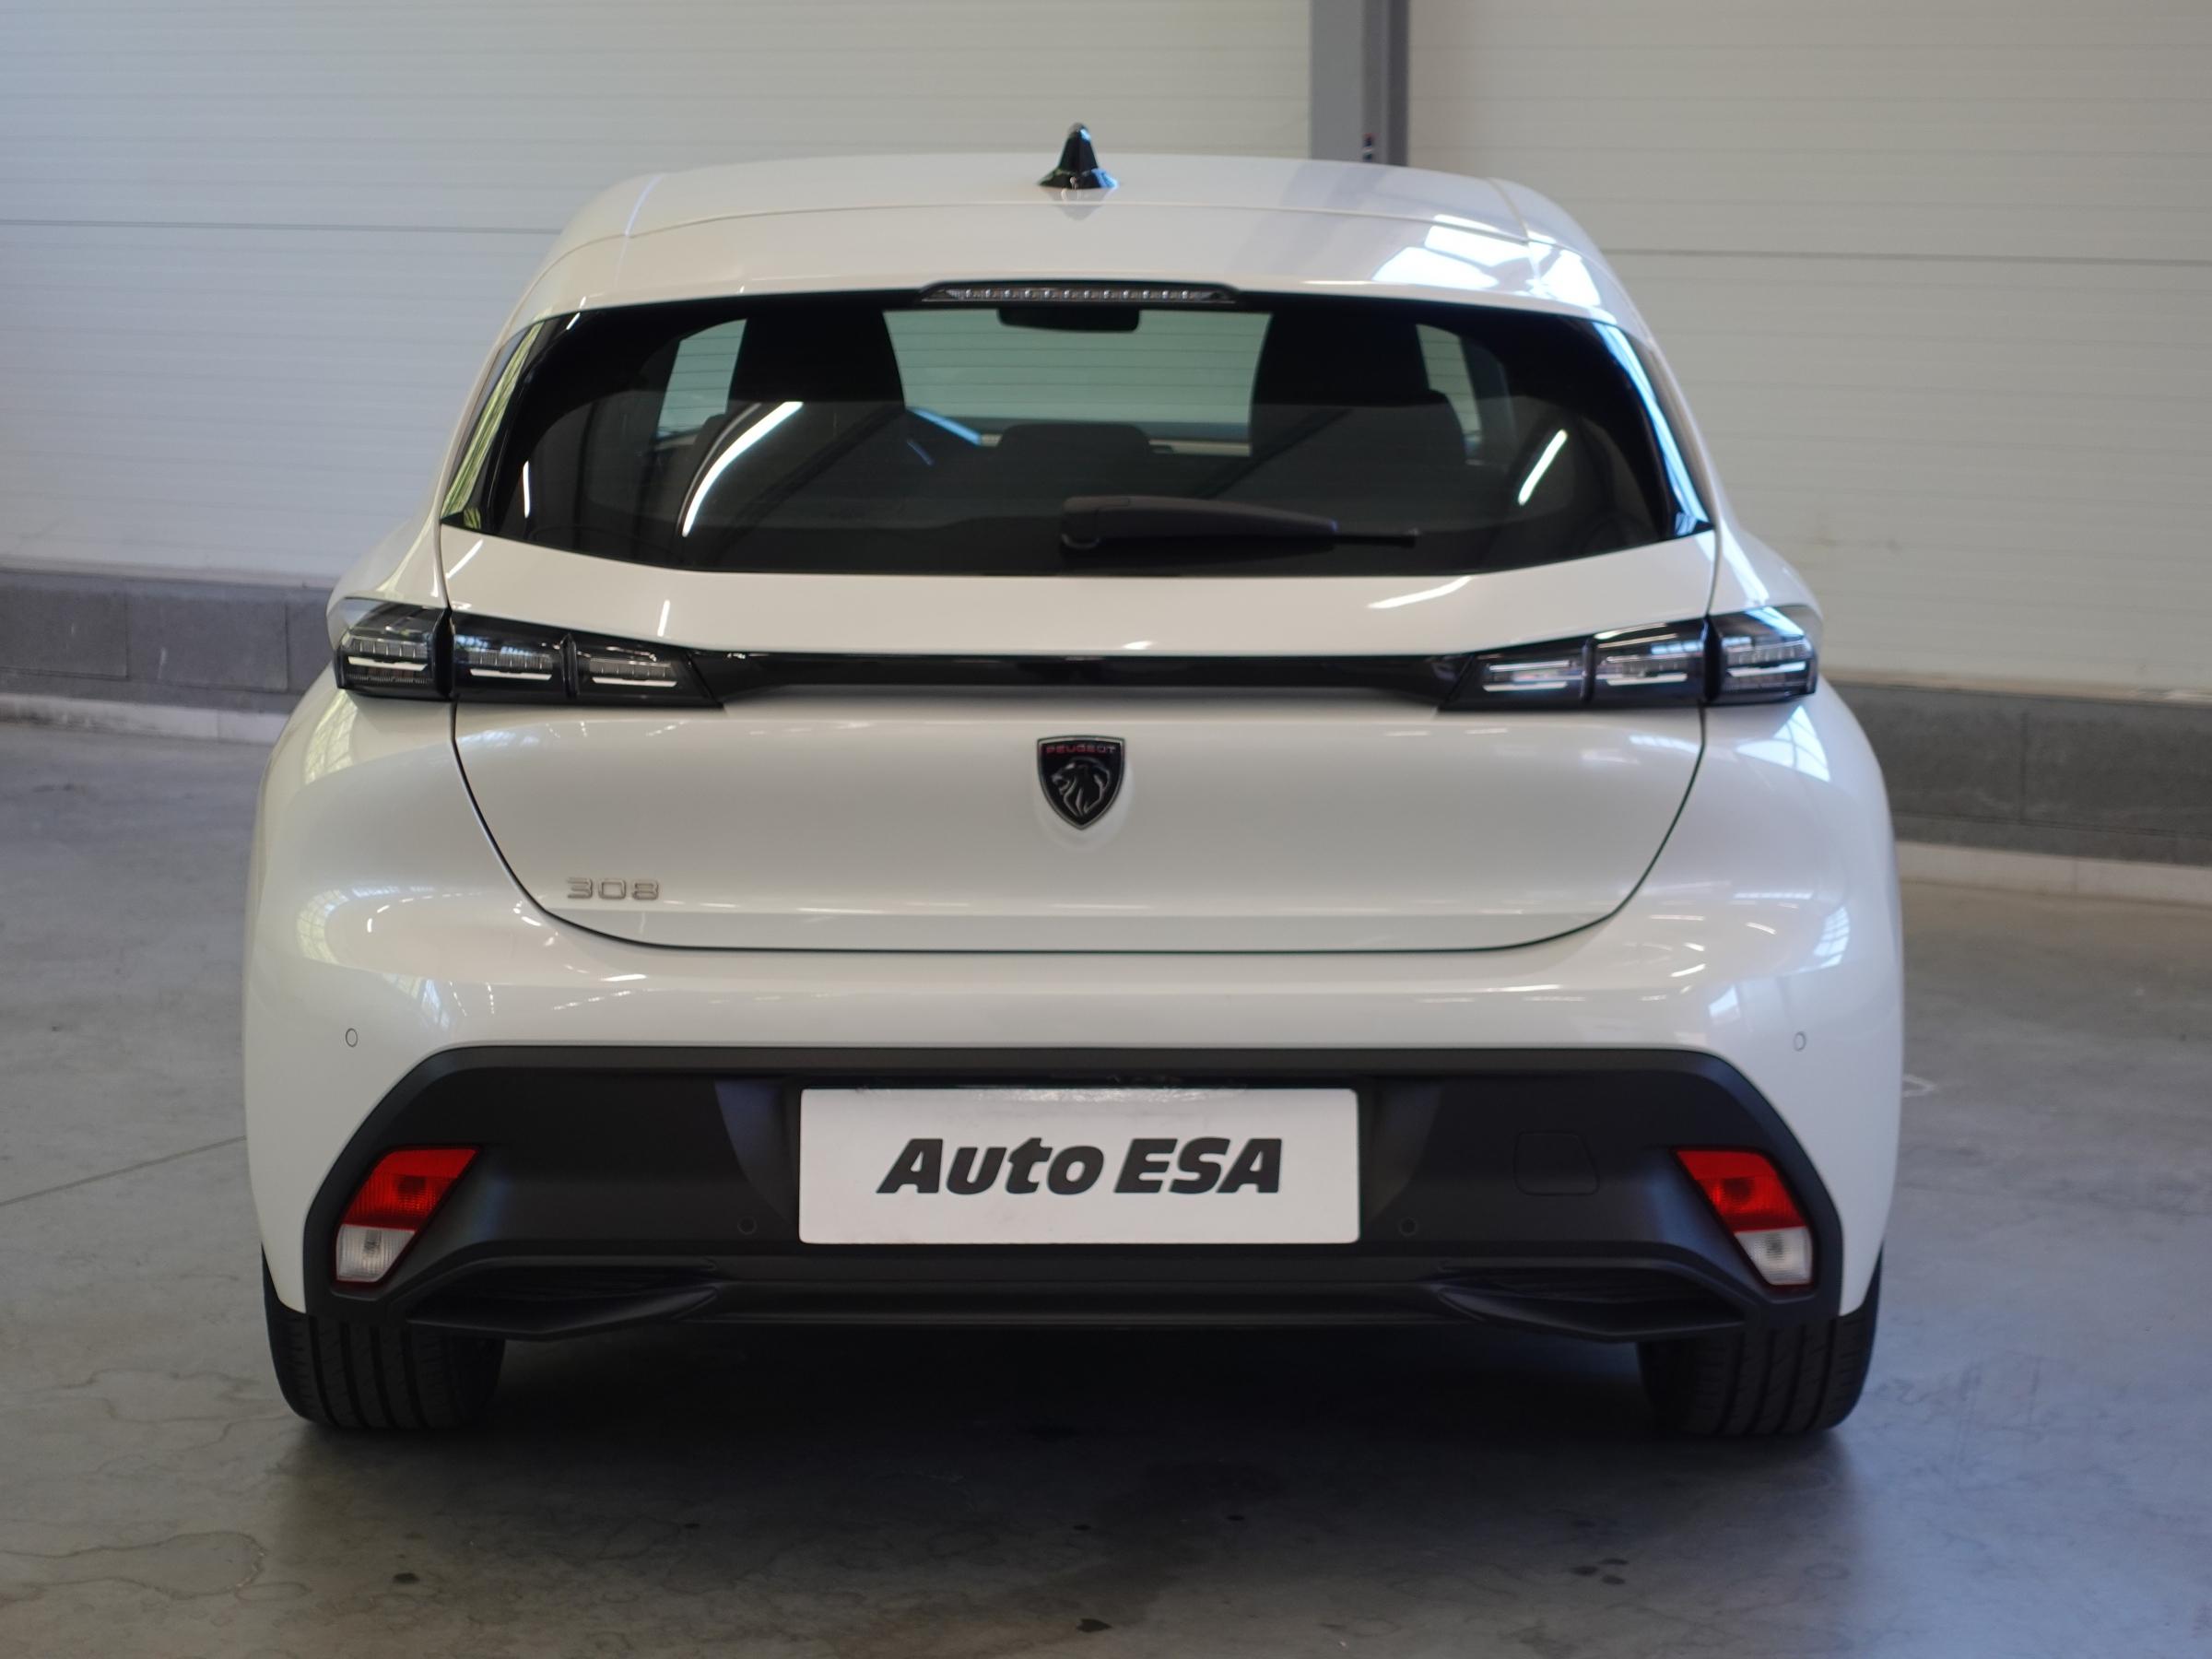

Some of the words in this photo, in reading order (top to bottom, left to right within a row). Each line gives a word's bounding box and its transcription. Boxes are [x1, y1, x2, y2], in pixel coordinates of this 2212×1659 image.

[1046, 744, 1116, 753] PEUGEOT
[567, 877, 659, 900] 308
[877, 1137, 1104, 1194] Auto
[1113, 1137, 1282, 1194] ESA
